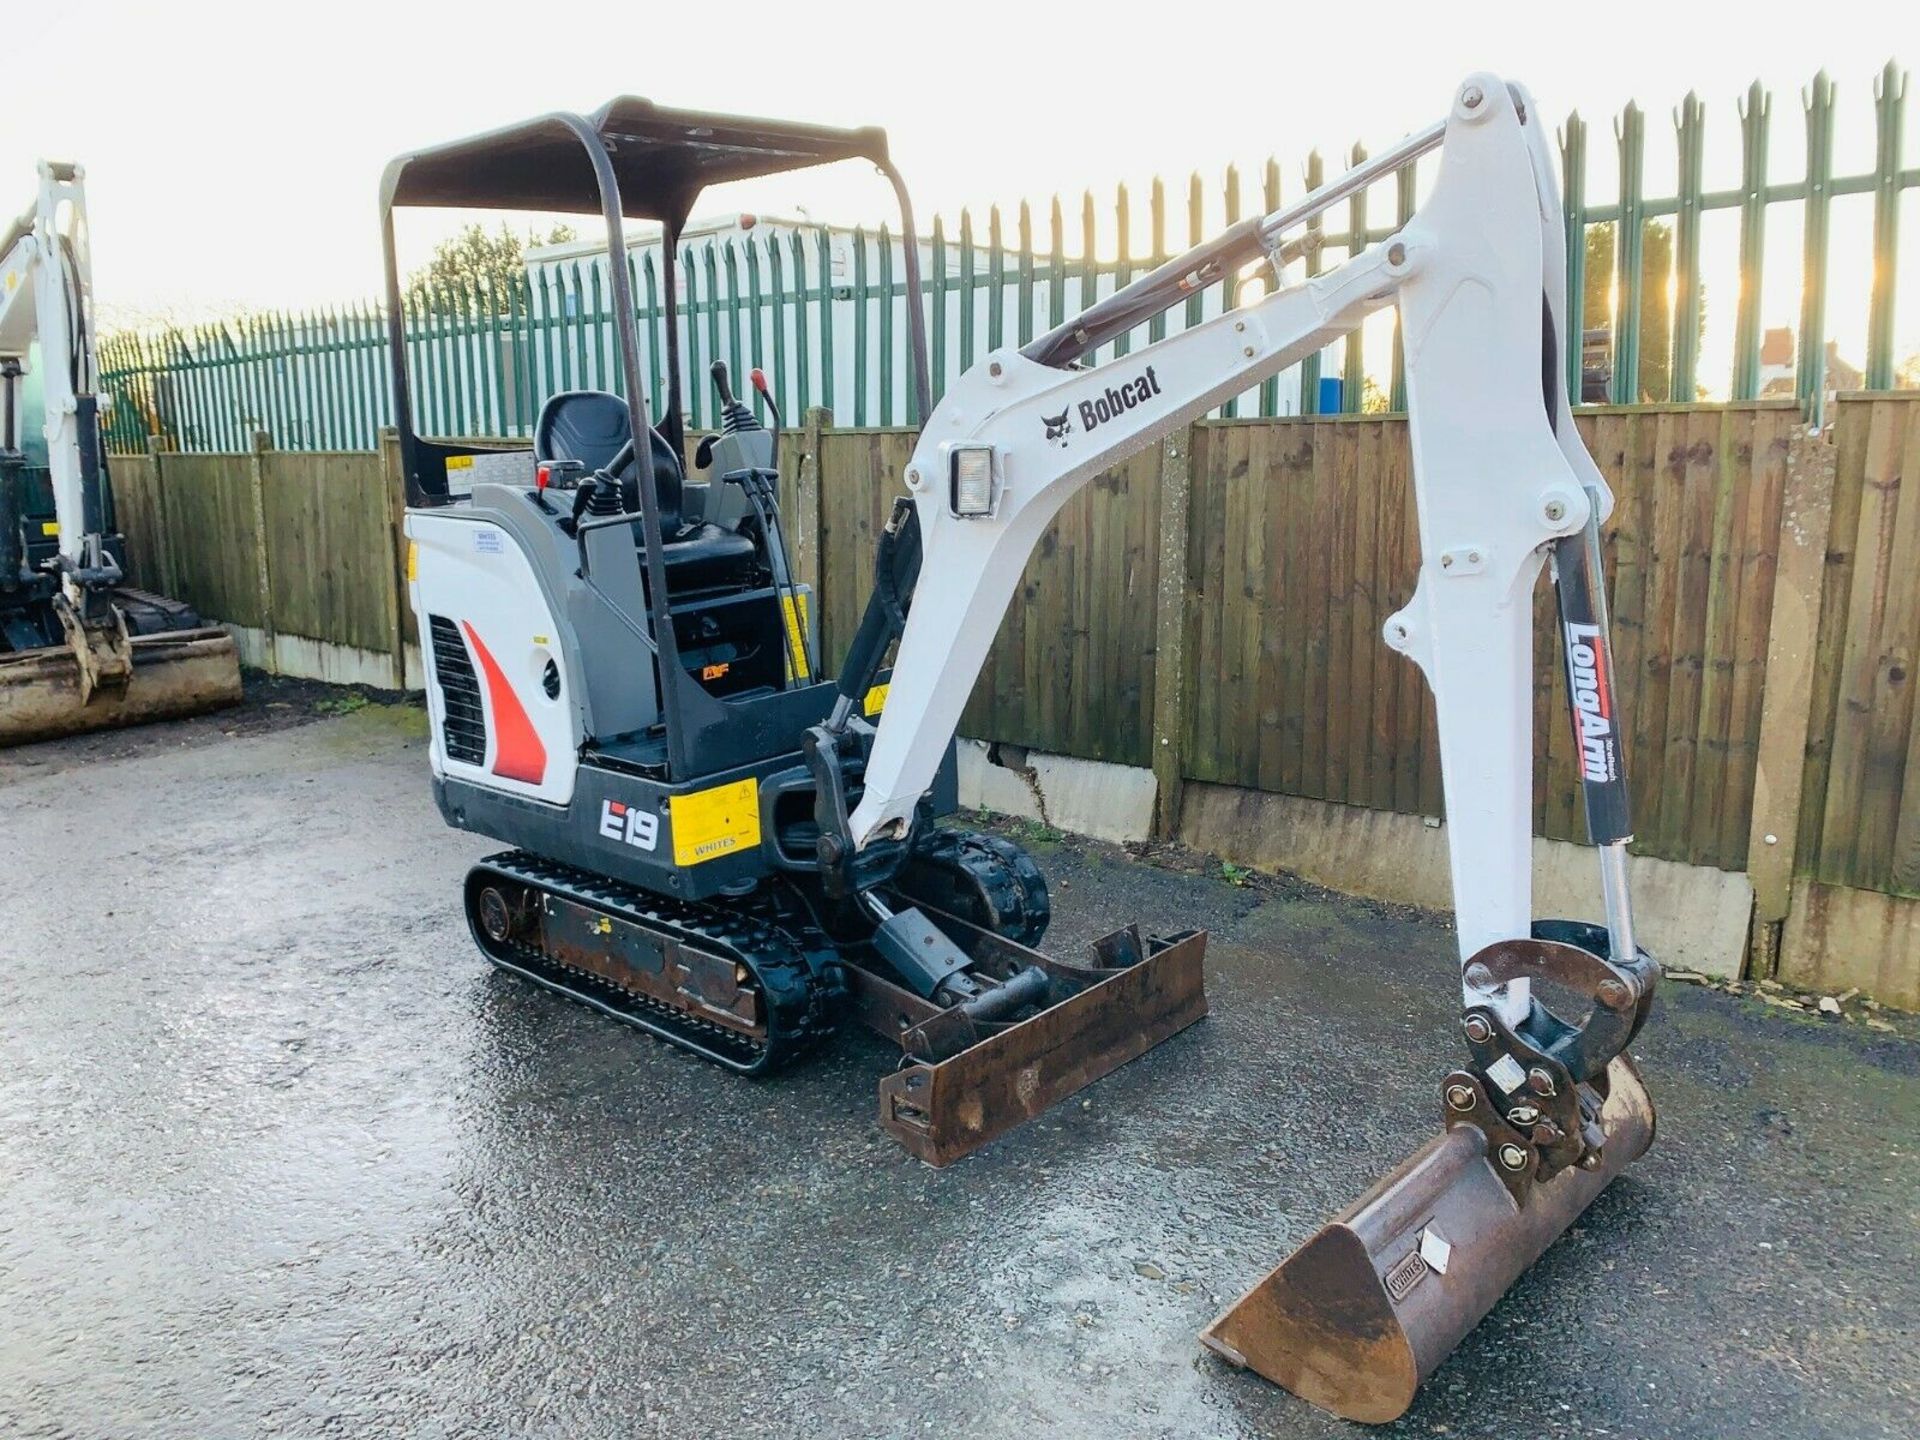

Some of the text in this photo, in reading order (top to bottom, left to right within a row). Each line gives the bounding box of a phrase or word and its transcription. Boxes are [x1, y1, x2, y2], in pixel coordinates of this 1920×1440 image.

[1078, 365, 1161, 432] Bobcat
[1570, 622, 1610, 784] LongArm
[599, 799, 659, 852] E19
[694, 836, 737, 857] WHITES
[1389, 1258, 1421, 1292] WHITES
